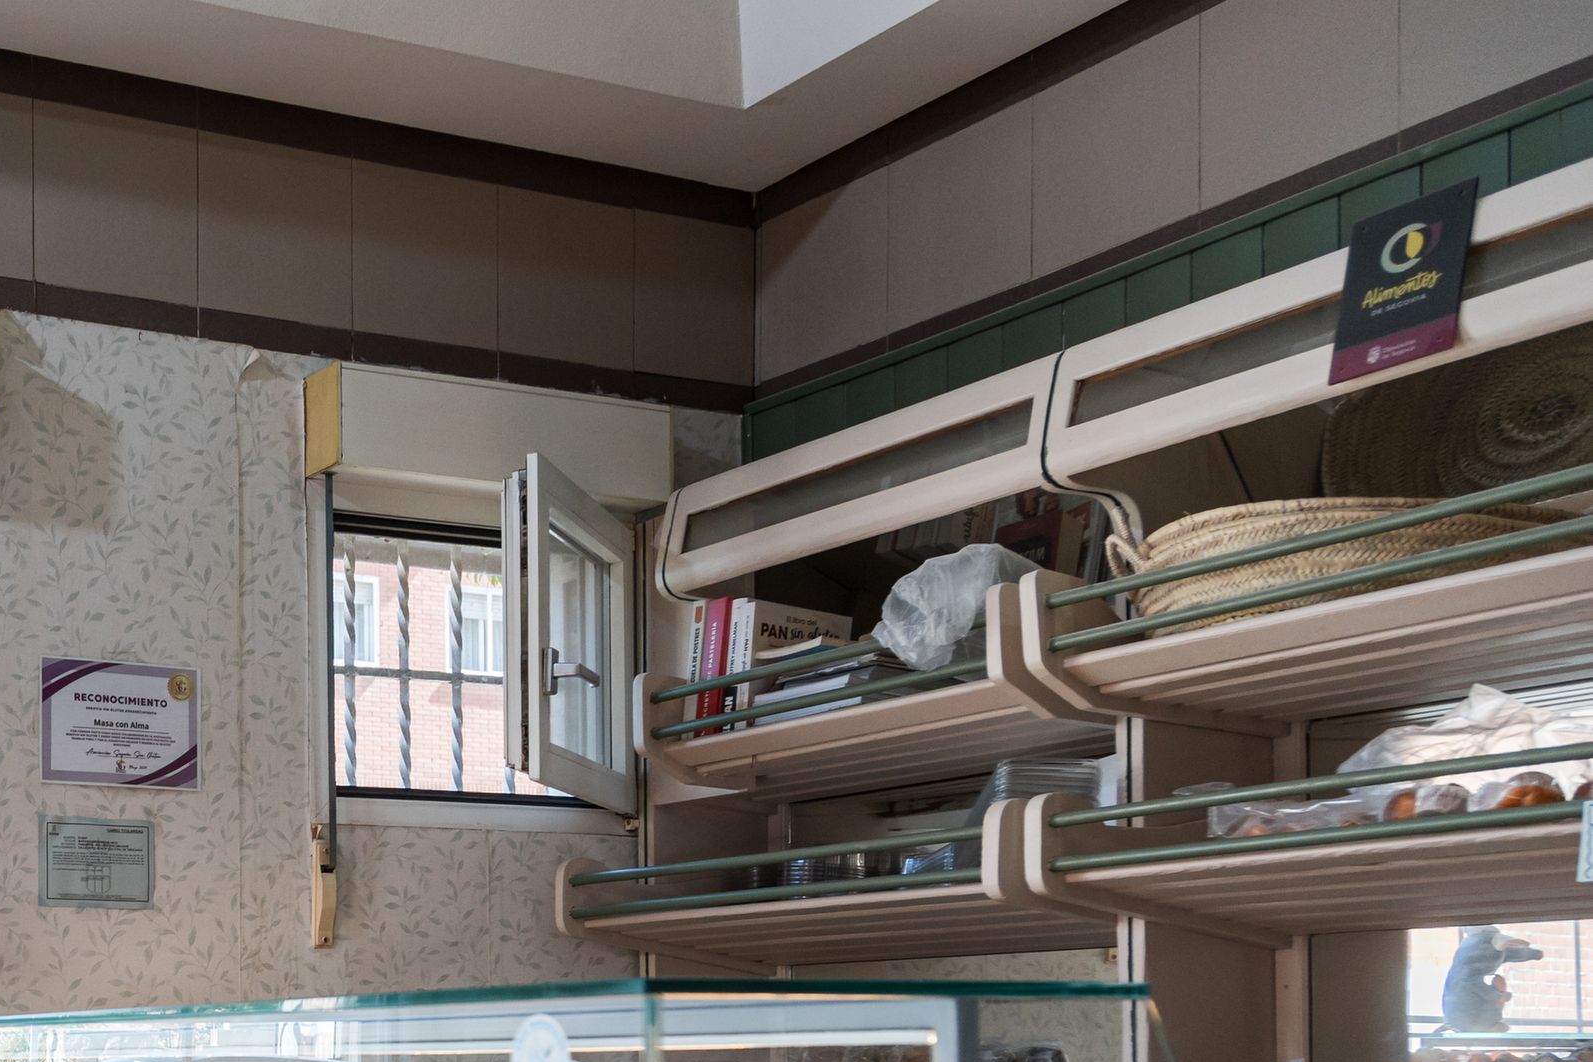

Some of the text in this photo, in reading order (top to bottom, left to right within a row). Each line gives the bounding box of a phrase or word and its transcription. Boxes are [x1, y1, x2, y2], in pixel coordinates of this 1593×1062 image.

[1360, 270, 1443, 310] Alimentos
[692, 627, 701, 655] POSTRES
[760, 622, 788, 641] PAN
[790, 627, 804, 641] sin
[74, 692, 168, 708] RECONOCIMIENTO
[93, 719, 114, 728] Masa
[130, 721, 149, 730] Alma
